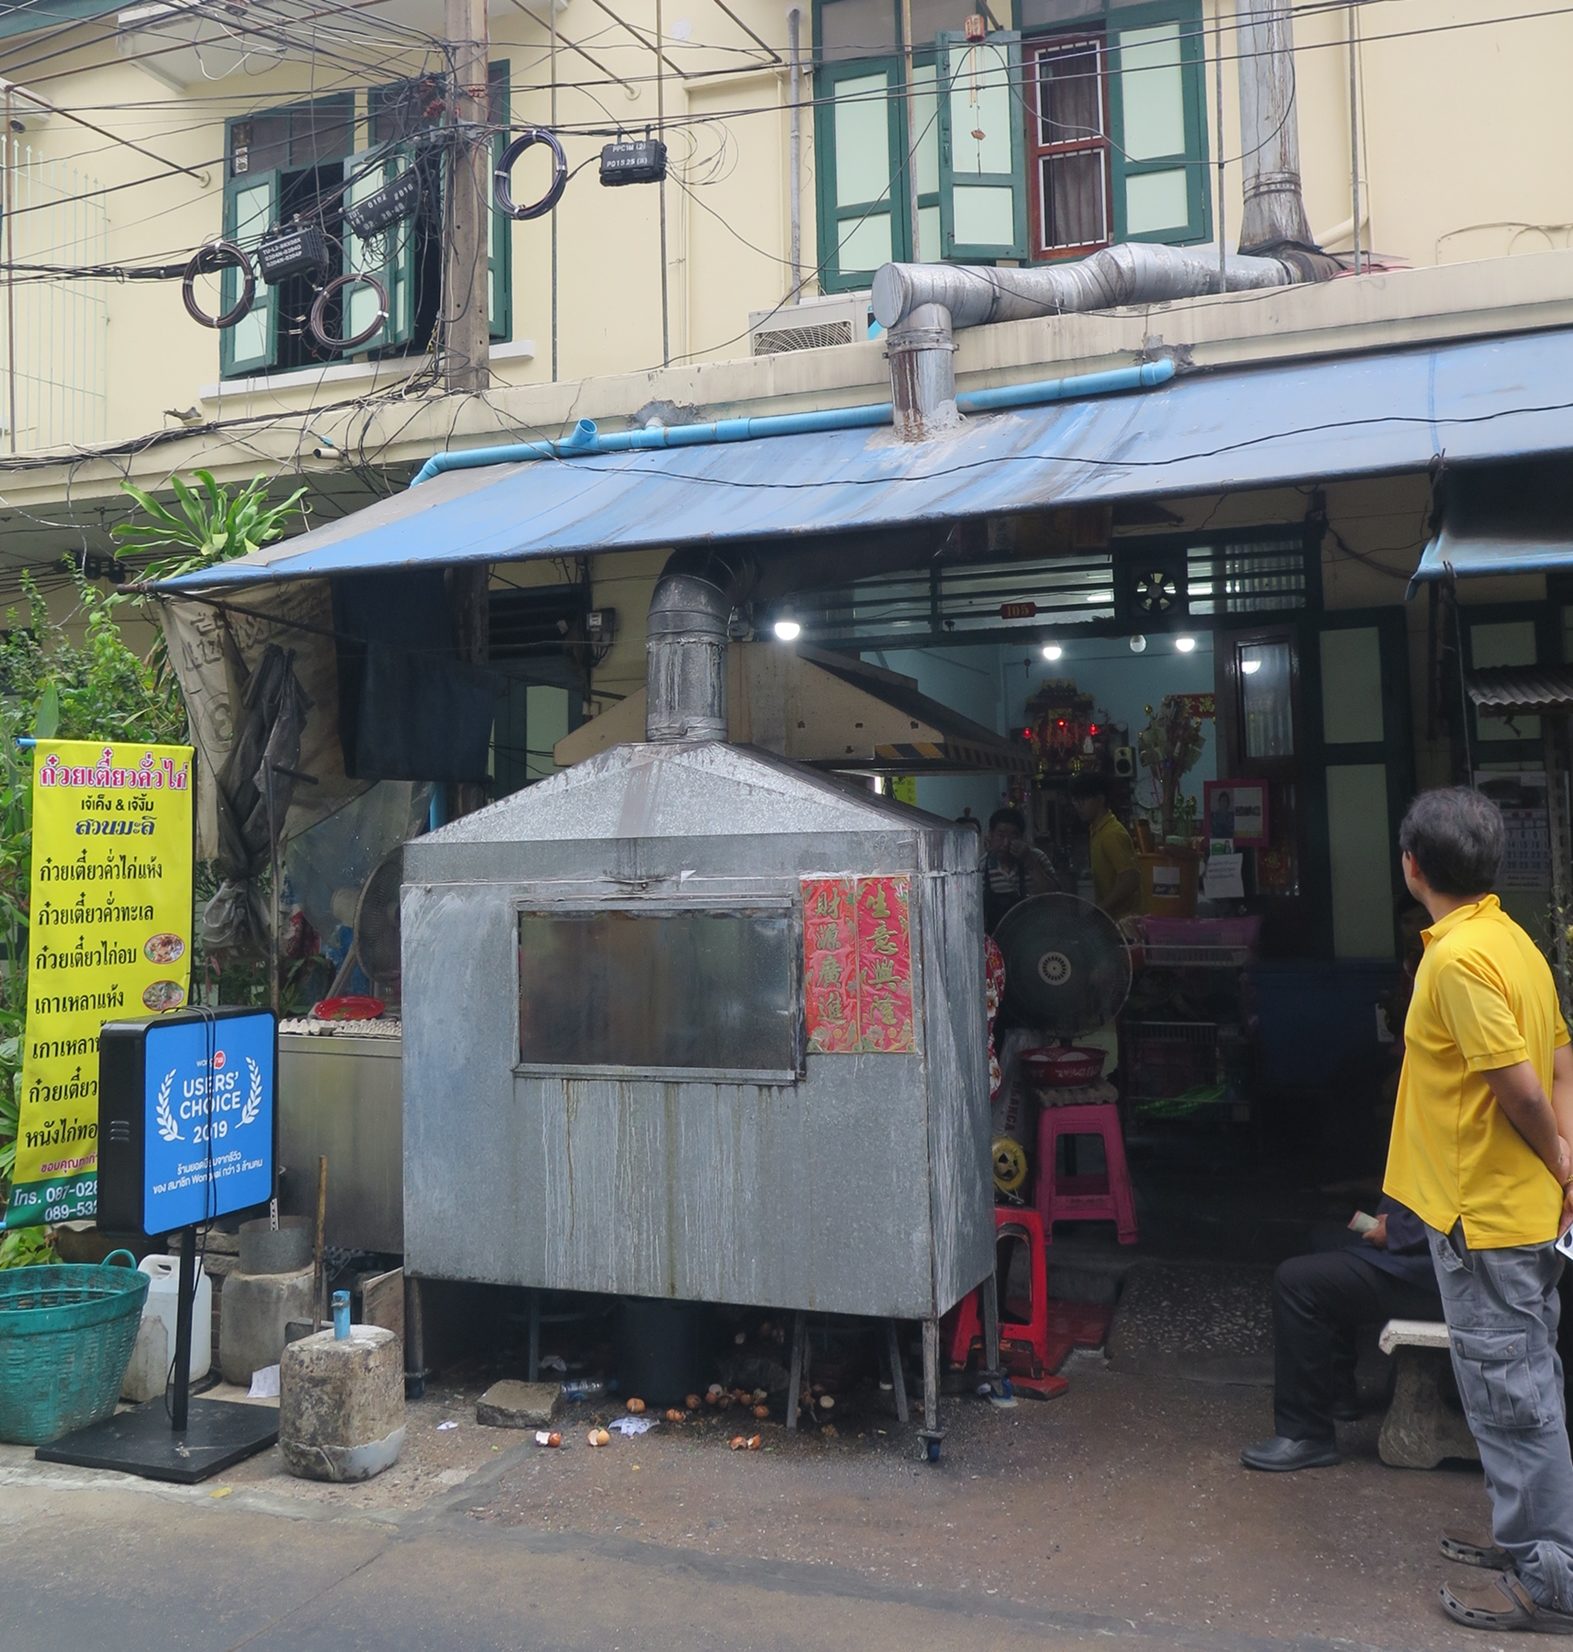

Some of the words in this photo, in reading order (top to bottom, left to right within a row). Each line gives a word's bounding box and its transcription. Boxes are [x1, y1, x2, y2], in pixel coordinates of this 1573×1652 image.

[40, 747, 189, 790] ก๋วยเตี๋ยวคั่วไก่
[115, 798, 125, 811] &
[75, 815, 157, 836] สวนมะลิ
[39, 848, 163, 882] ก๋วยเตี๋ยวคั่วไก่แห้ง
[38, 891, 154, 926] ก๋วยเตี๋ยวคั่วทะเล
[36, 935, 138, 970] ก๋วยเตี๋ยวไก่อบ
[35, 984, 124, 1014] เกาเหลาแห้ง
[180, 1091, 241, 1120] CHOICE
[192, 1120, 228, 1144] 2019
